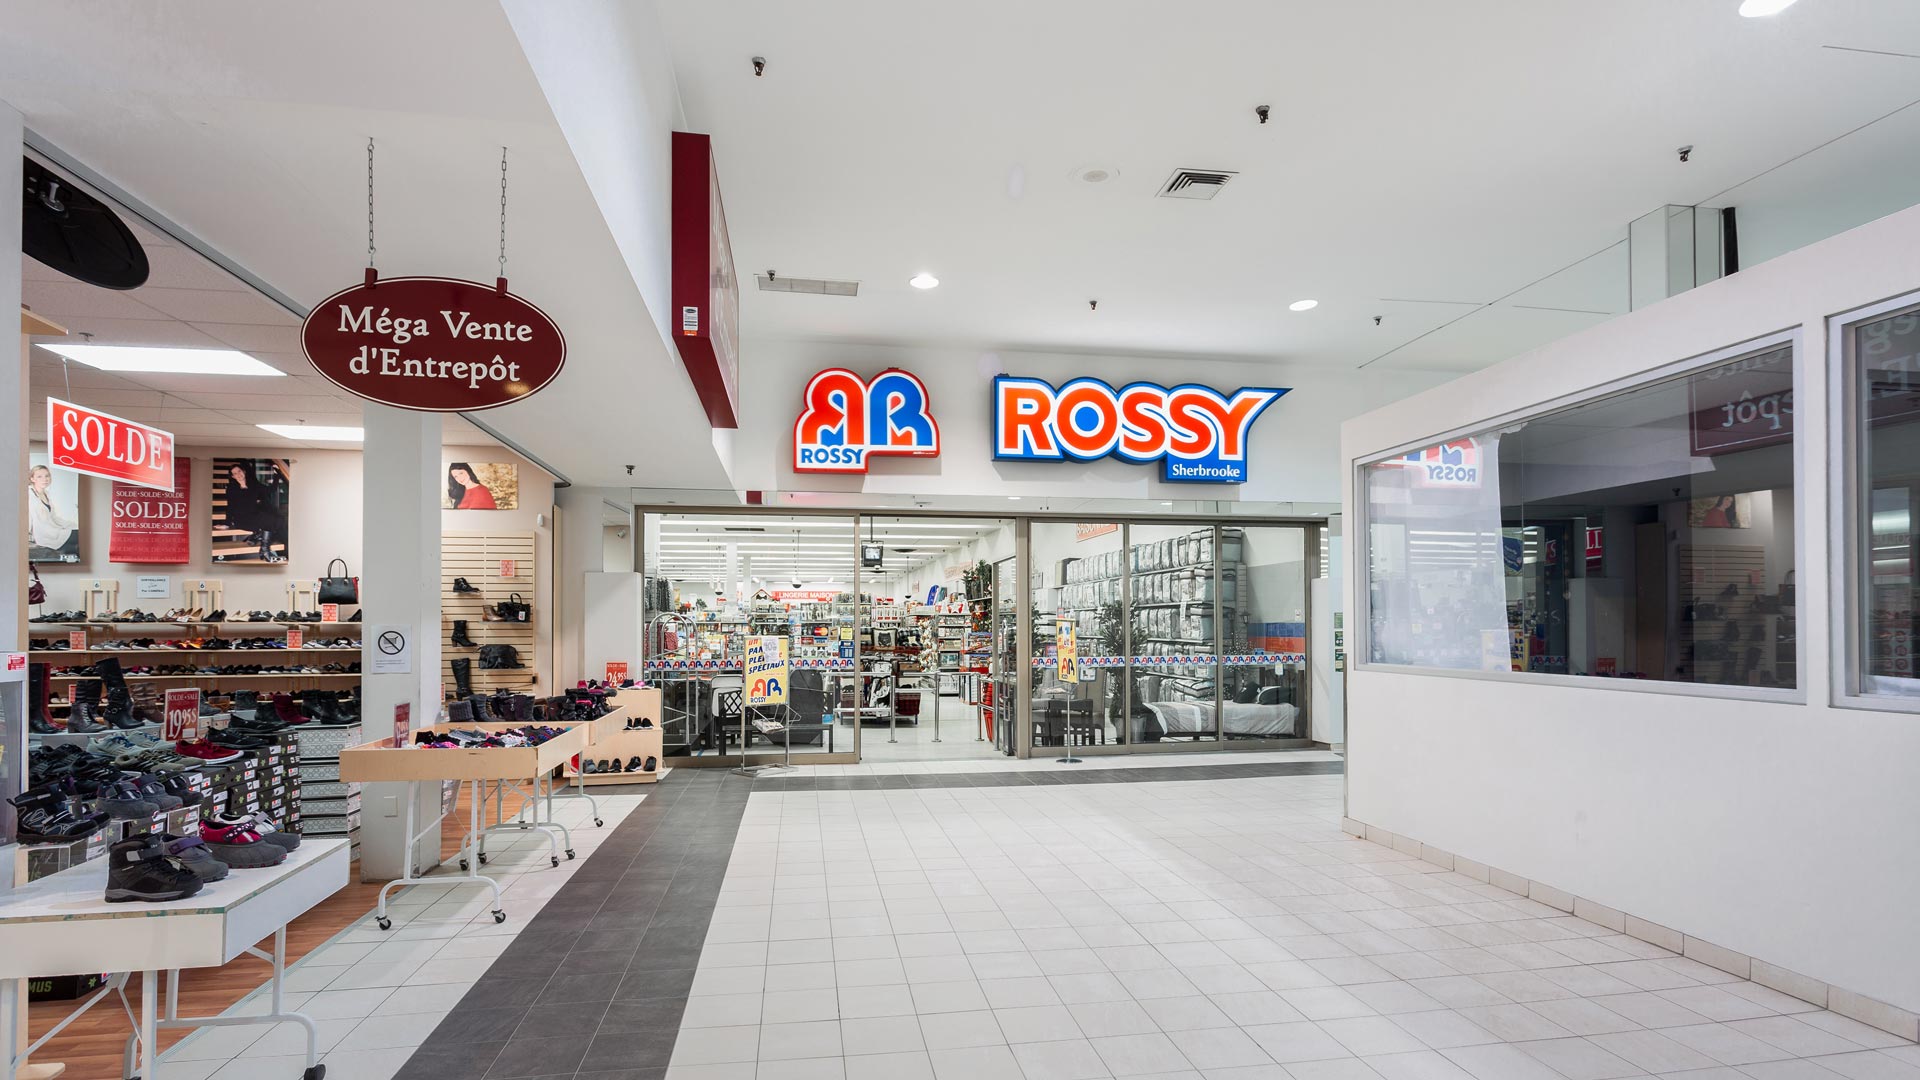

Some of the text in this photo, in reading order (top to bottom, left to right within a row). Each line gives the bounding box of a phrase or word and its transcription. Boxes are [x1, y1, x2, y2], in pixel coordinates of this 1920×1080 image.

[337, 304, 533, 344] Méga Vente
[349, 345, 520, 389] d'Entrepôt
[61, 409, 165, 471] SOLDE
[1003, 386, 1266, 457] ROSSY
[801, 448, 864, 464] ROSSY
[1172, 464, 1240, 477] Sherbrooke
[113, 501, 187, 519] SOLDE
